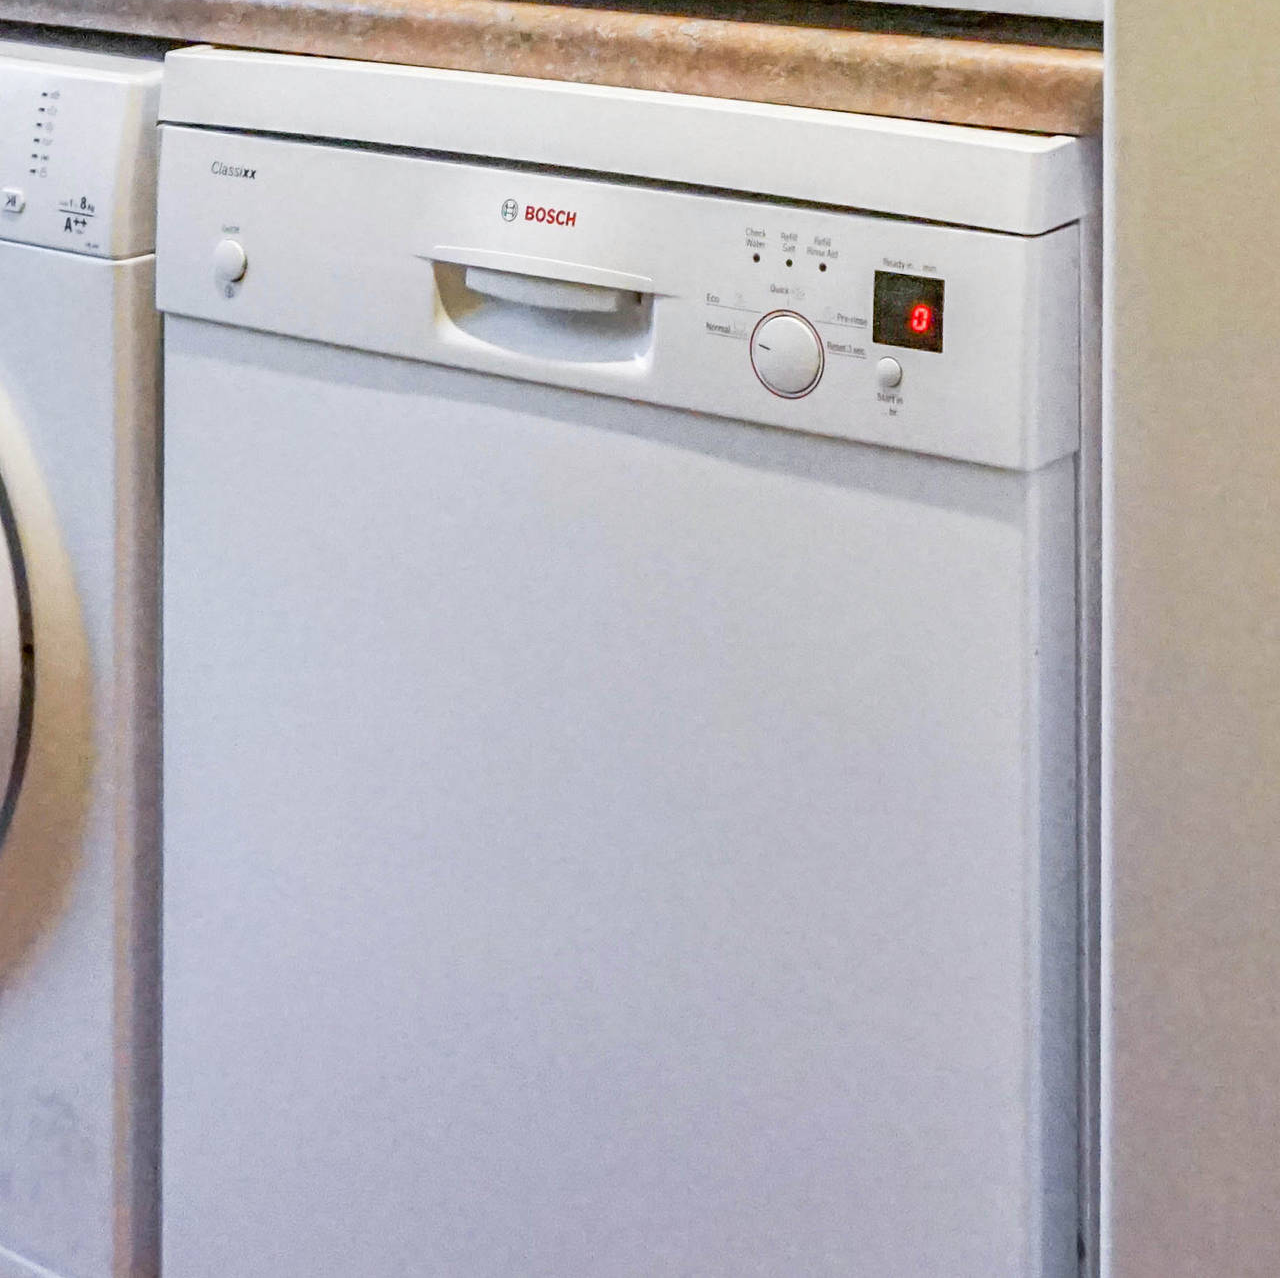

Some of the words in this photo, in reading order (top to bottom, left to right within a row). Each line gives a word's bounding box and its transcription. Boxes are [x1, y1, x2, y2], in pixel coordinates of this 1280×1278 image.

[210, 160, 257, 180] Classixx
[524, 204, 578, 228] BOSCH
[744, 227, 767, 239] Check
[706, 292, 721, 304] Eco
[706, 321, 732, 334] Normal
